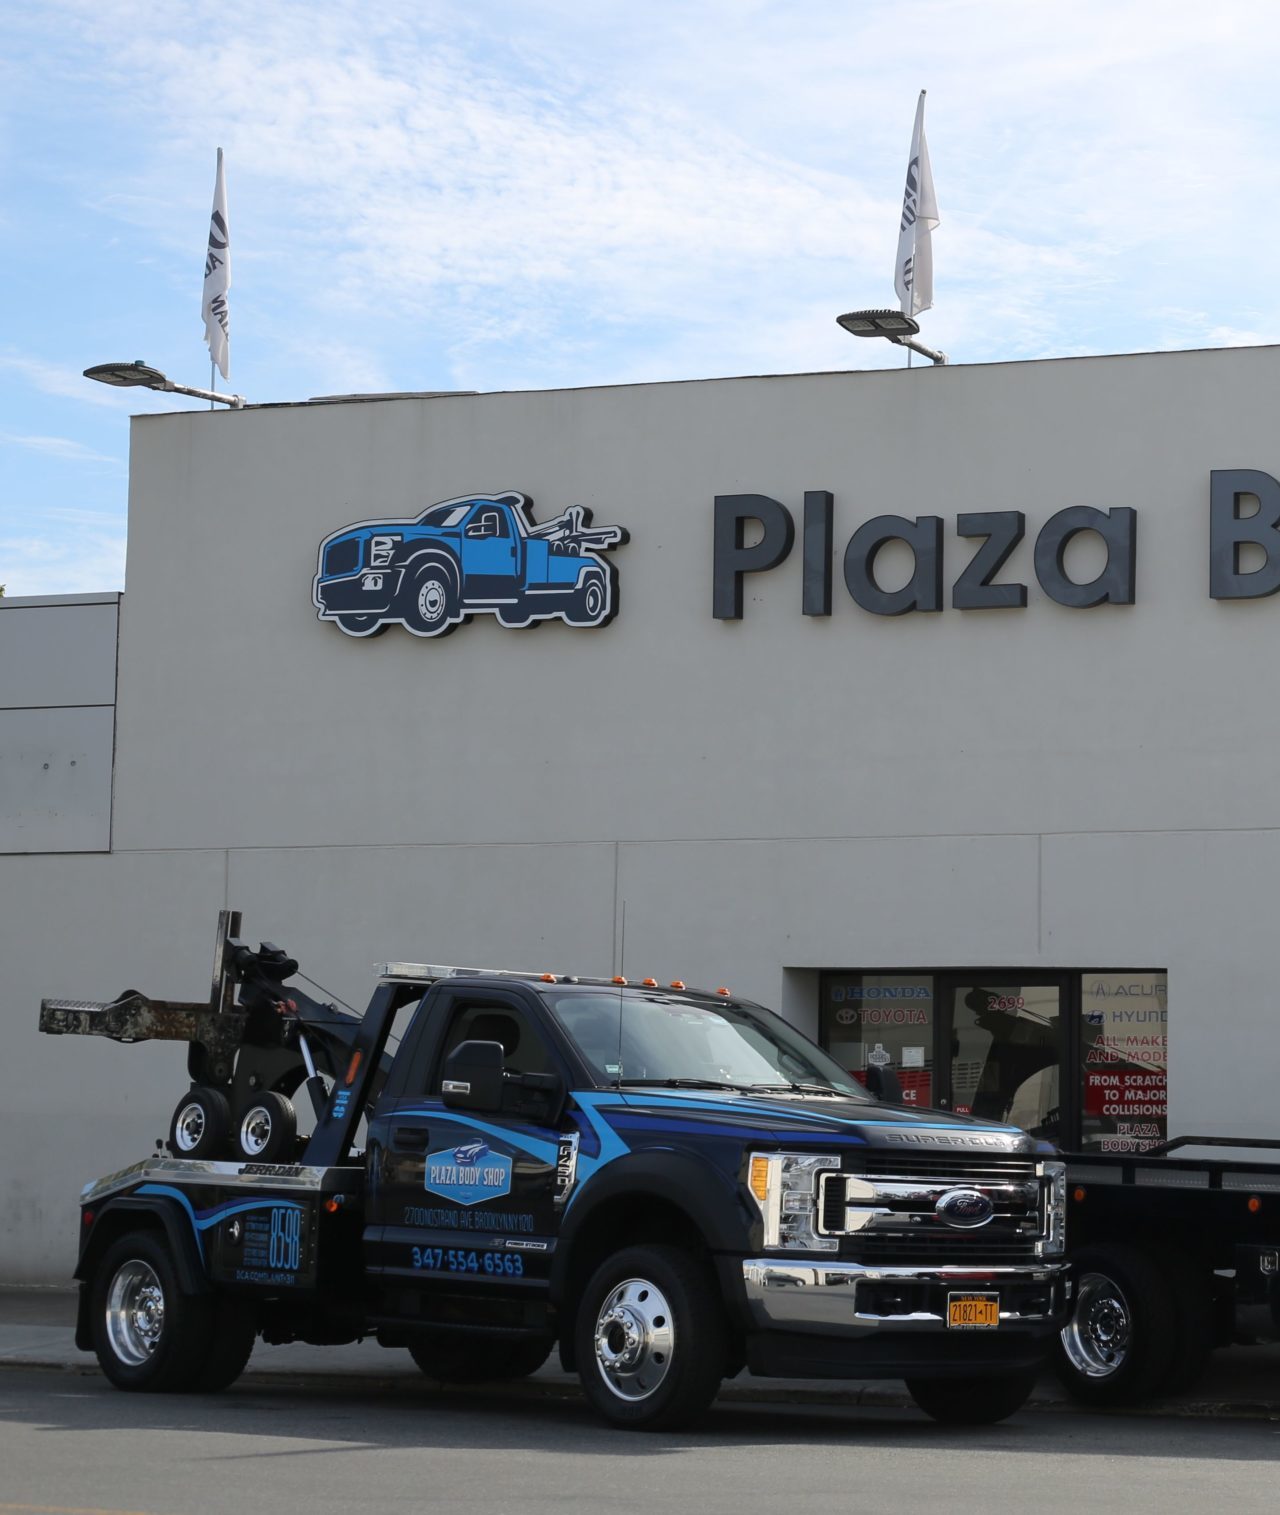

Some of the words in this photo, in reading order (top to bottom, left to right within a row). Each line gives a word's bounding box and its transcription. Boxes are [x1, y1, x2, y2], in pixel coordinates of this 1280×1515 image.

[712, 489, 1138, 621] Plaza
[847, 986, 931, 999] HONDA
[1114, 984, 1168, 996] ACUR
[987, 996, 1025, 1011] 2699
[857, 1008, 928, 1024] TOYOTA
[1112, 1010, 1168, 1023] HYUND
[1095, 1034, 1119, 1047] ALL
[1125, 1034, 1168, 1047] MAKE
[1087, 1049, 1120, 1063] AND
[1125, 1050, 1168, 1063] MODE
[1089, 1075, 1120, 1086] FROM
[1104, 1089, 1119, 1100] TO
[1124, 1089, 1168, 1100] MAJOR
[1102, 1104, 1168, 1115] COLLISIONS
[1117, 1123, 1160, 1137] PLAZA
[1101, 1138, 1138, 1152] BODY
[1139, 1139, 1167, 1152] SH
[430, 1166, 457, 1185] PLAZA
[459, 1166, 481, 1185] BODY
[483, 1167, 506, 1186] SHOP
[269, 1207, 301, 1271] 8598
